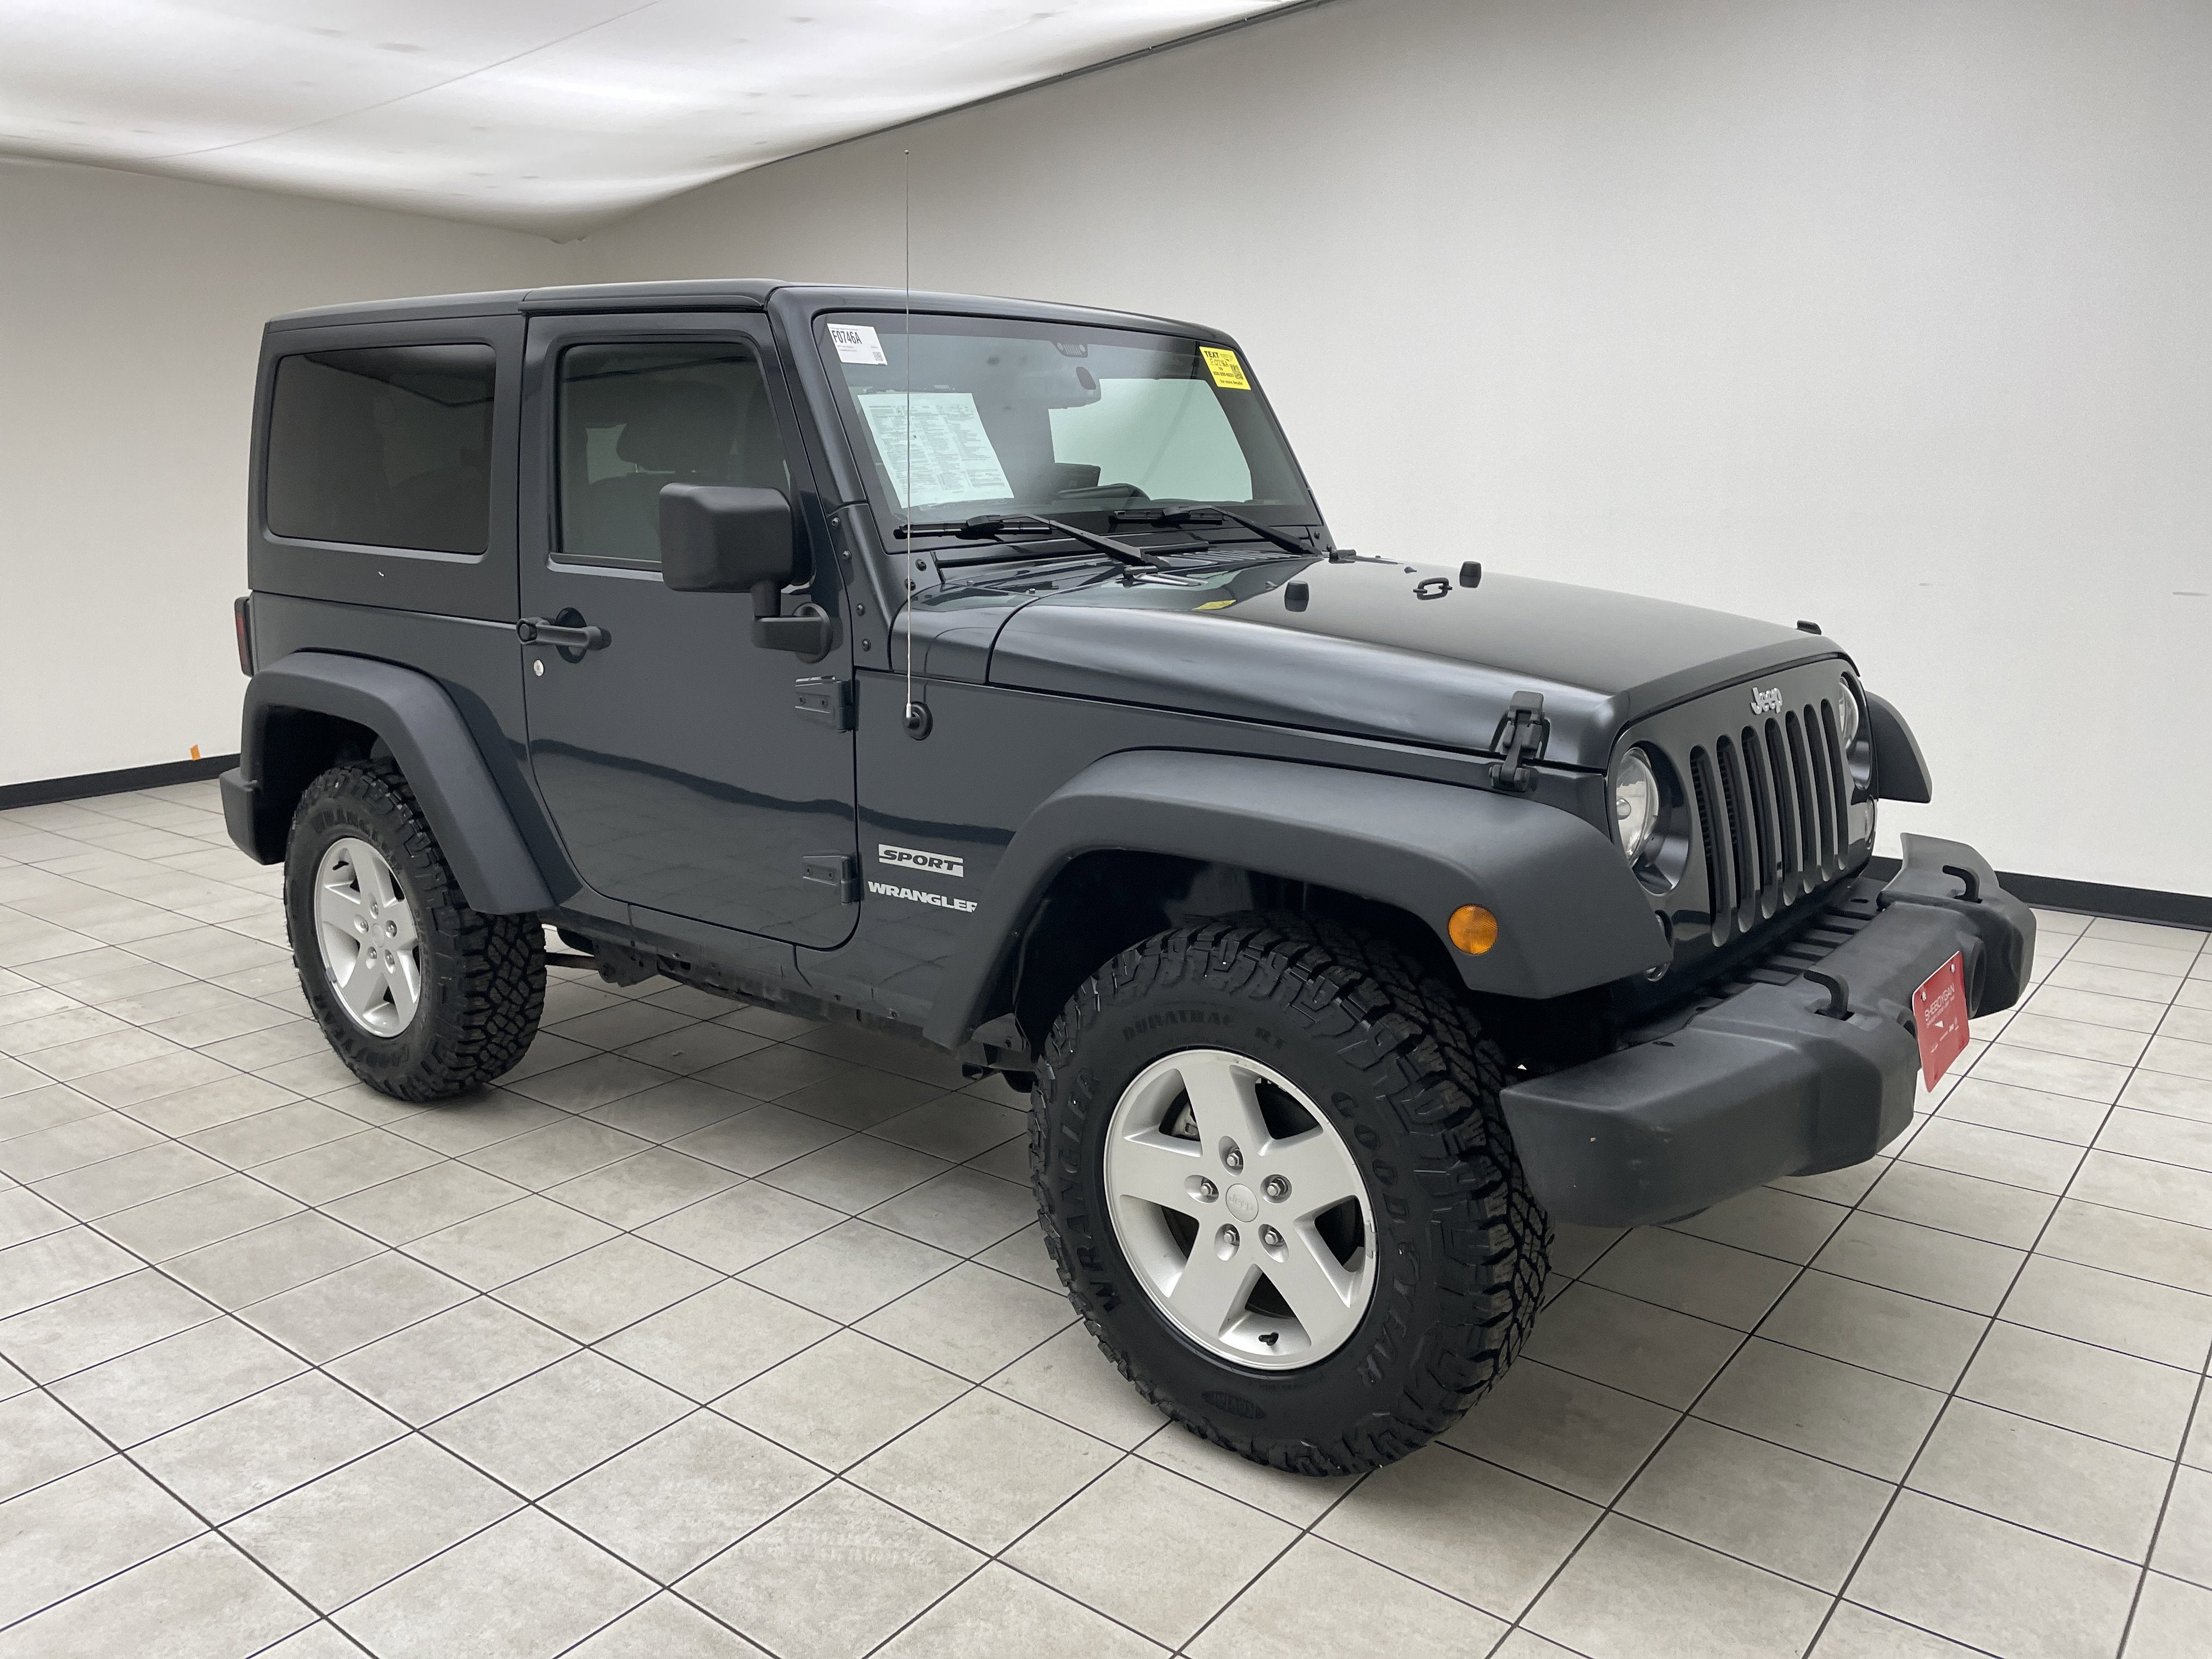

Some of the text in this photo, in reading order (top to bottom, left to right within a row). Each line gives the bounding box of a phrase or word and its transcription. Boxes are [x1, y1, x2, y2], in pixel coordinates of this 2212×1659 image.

[831, 330, 862, 345] F0746A
[1751, 687, 1783, 715] Jeep
[883, 850, 958, 871] SPORT
[867, 881, 978, 913] WRANGLER
[1924, 982, 1955, 1022] SHEBOYGAN
[1058, 1067, 1122, 1313] WRANGLER
[1229, 1194, 1253, 1214] Jeep
